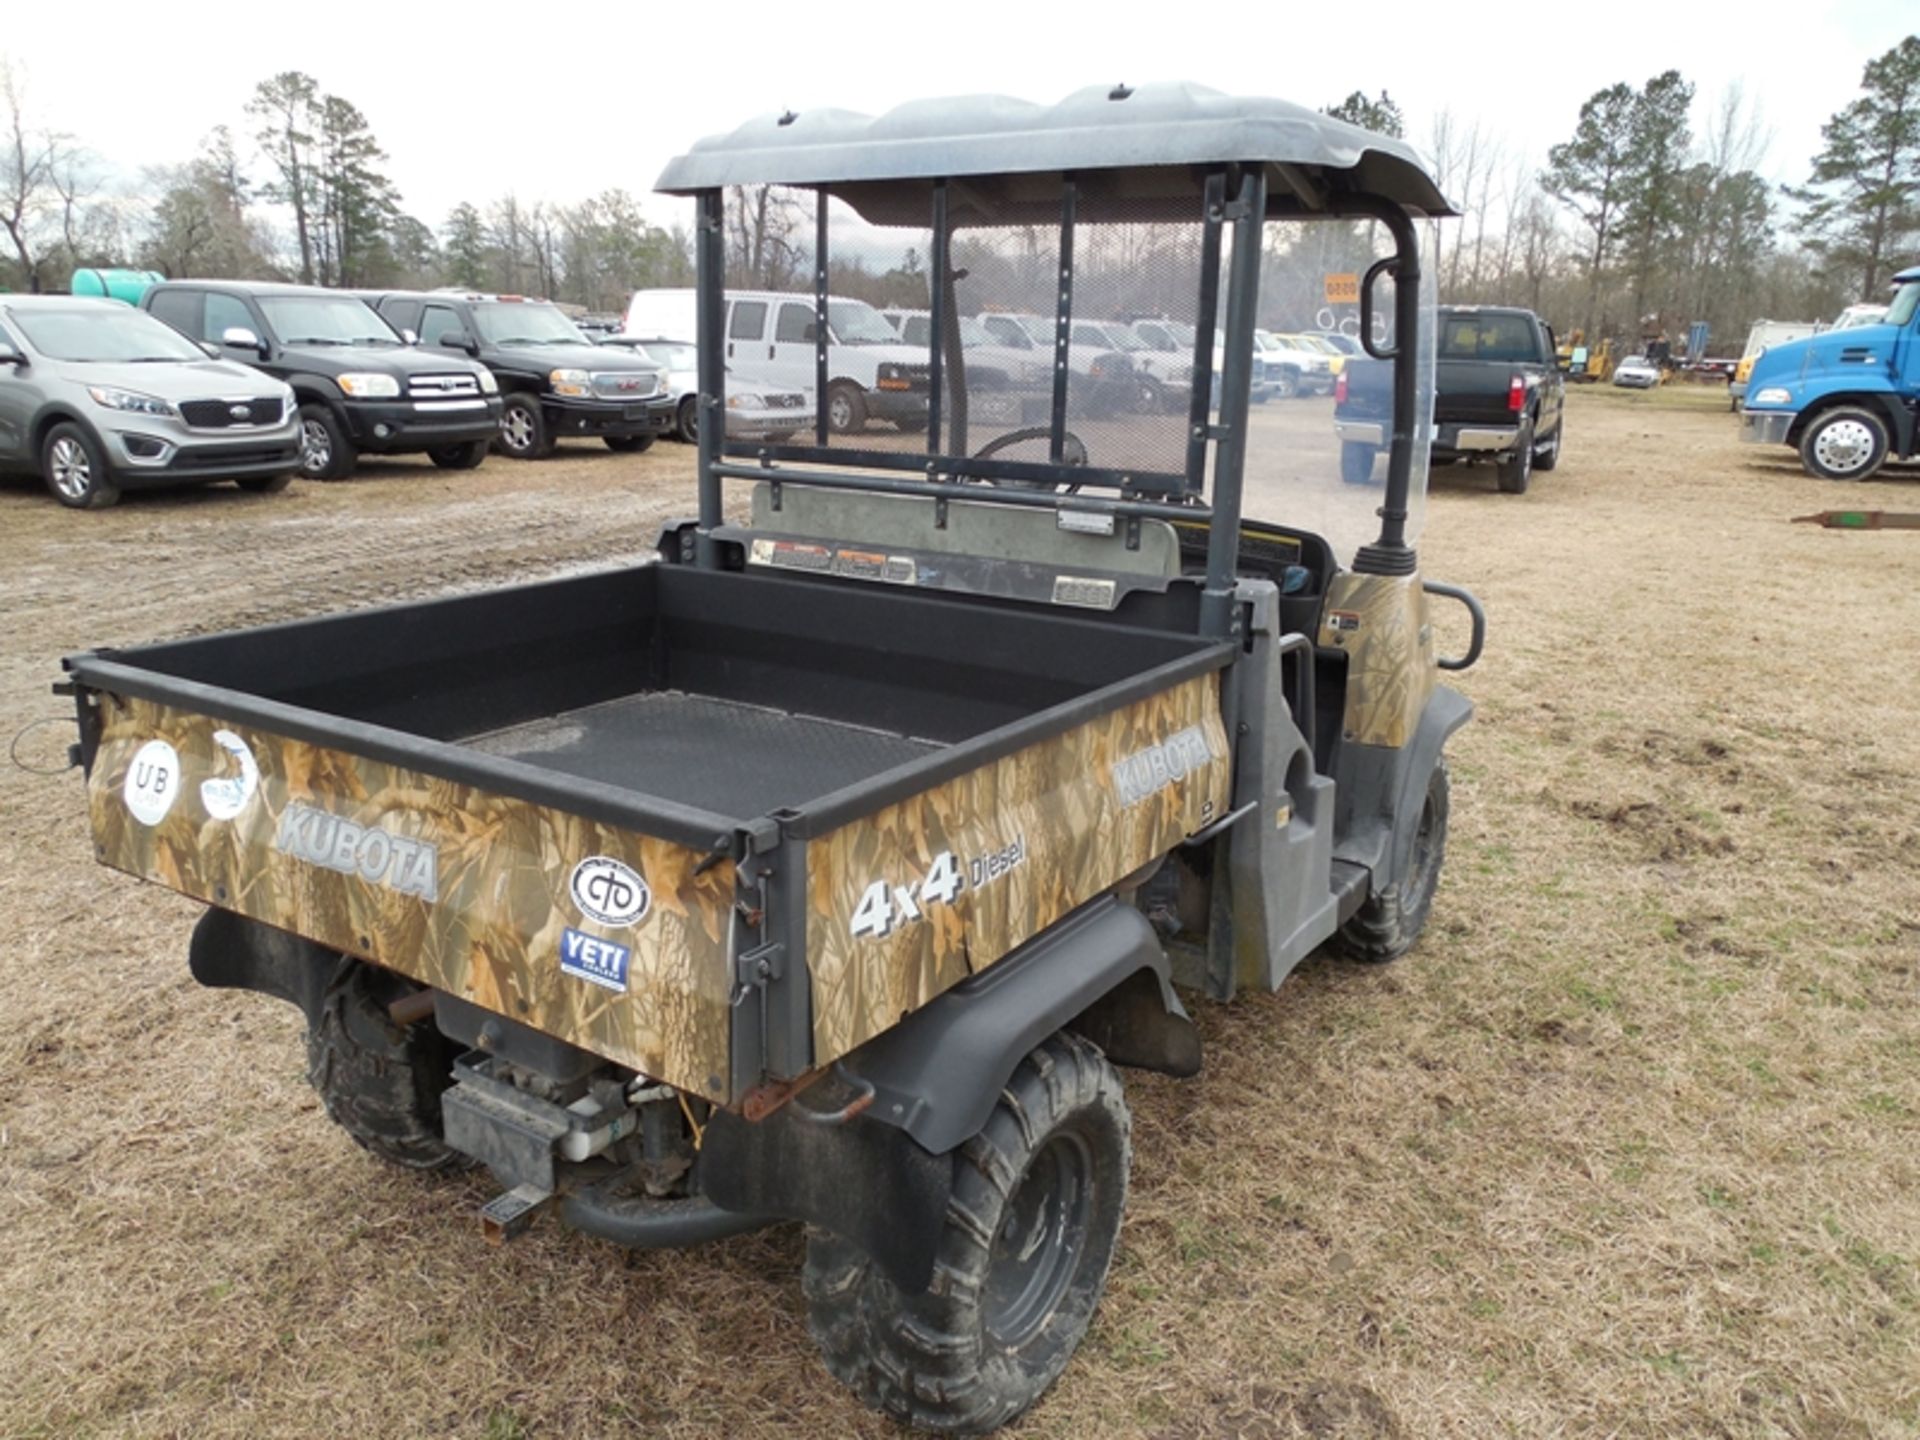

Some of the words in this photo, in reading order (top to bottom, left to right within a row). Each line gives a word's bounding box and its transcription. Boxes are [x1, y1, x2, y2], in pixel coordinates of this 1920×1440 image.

[1113, 725, 1211, 809] KUBOTA
[278, 802, 438, 902] KUBOTA
[851, 850, 964, 939] 4x4
[969, 833, 1025, 889] Diesel
[566, 931, 624, 973] YETI
